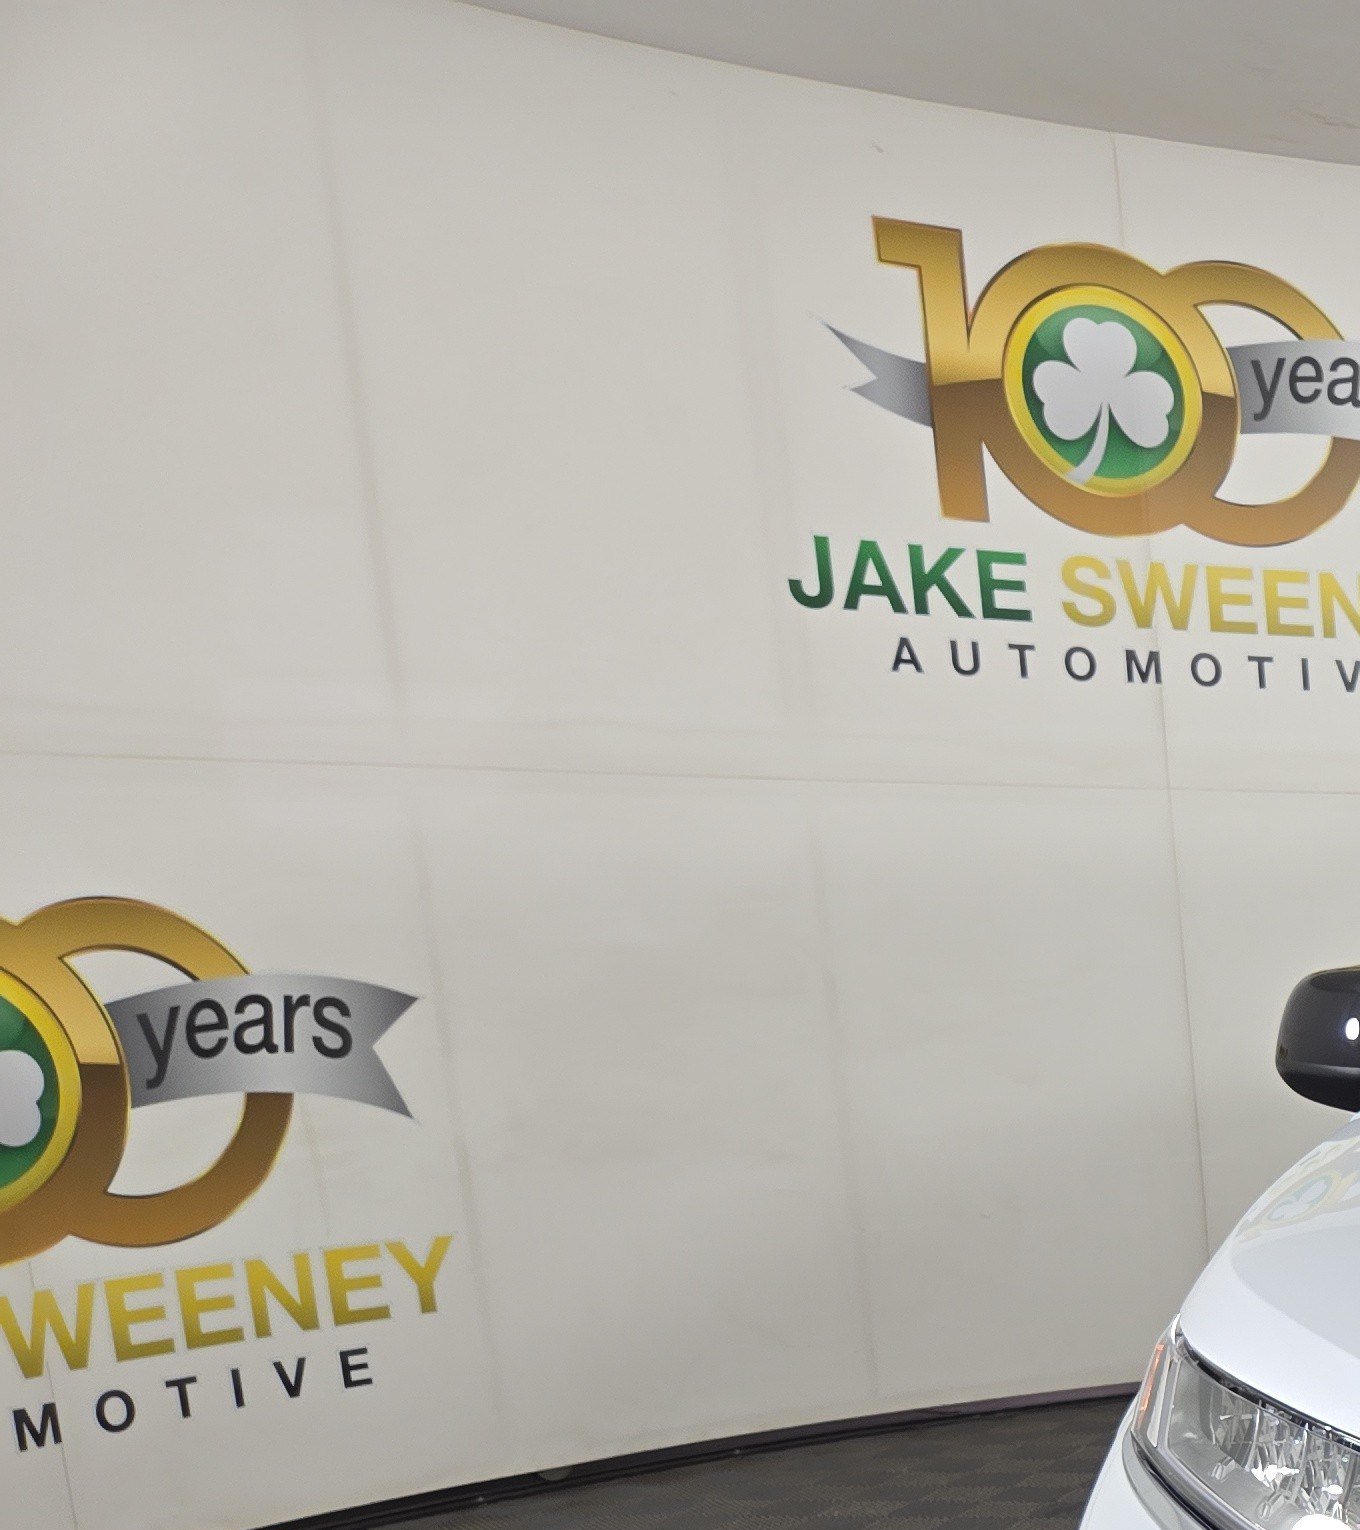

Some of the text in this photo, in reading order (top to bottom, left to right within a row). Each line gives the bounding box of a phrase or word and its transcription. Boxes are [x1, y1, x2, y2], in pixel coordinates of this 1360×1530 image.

[788, 534, 1033, 623] JAKE
[135, 993, 353, 1090] years
[12, 1347, 374, 1453] MOTIVE
